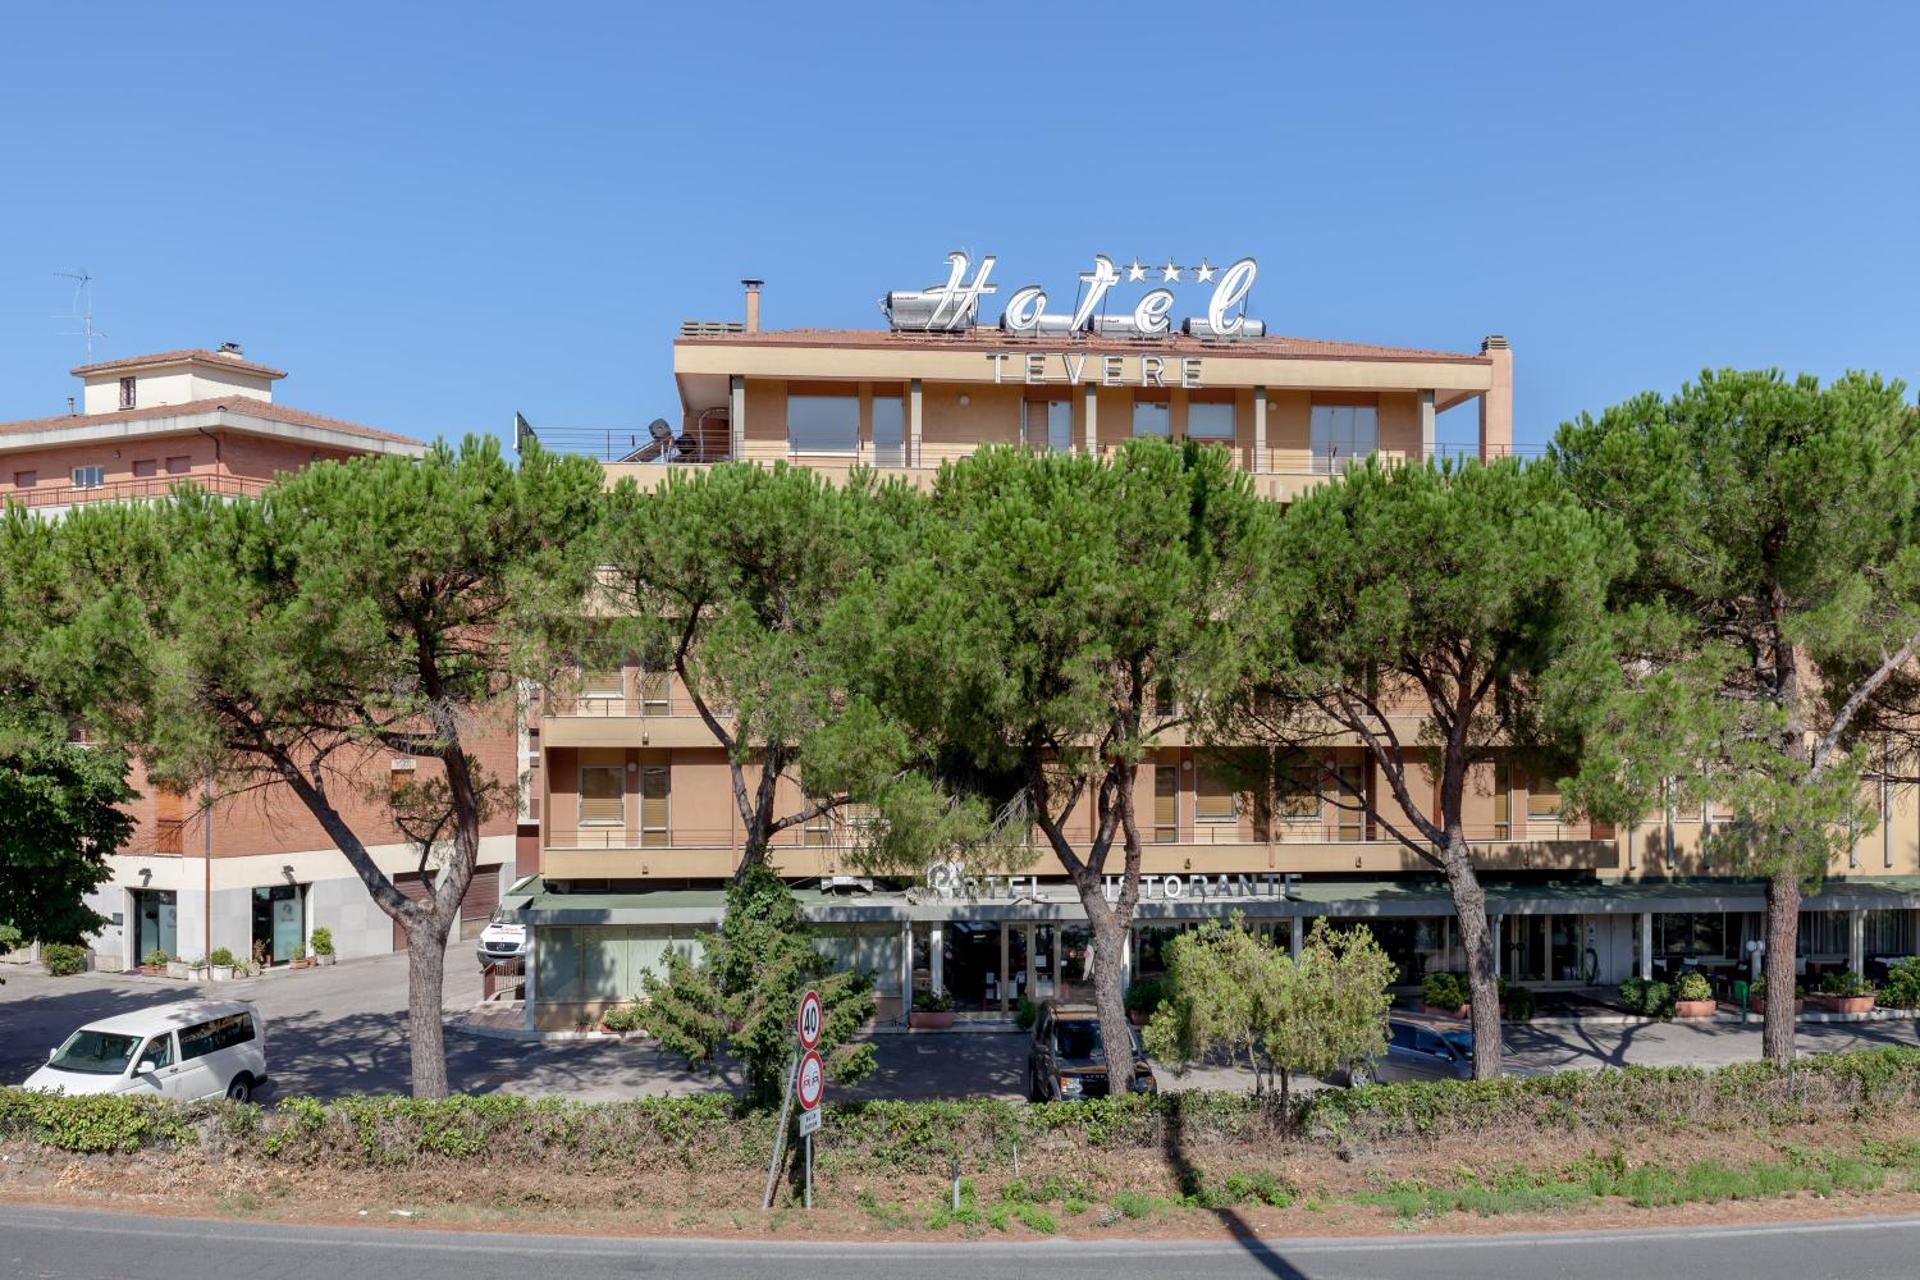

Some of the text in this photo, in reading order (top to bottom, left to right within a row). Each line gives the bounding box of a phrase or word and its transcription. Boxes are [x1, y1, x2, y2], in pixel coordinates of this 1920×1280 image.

[923, 251, 1257, 335] Hotel
[986, 351, 1203, 388] TEVERE
[804, 1006, 817, 1035] 40
